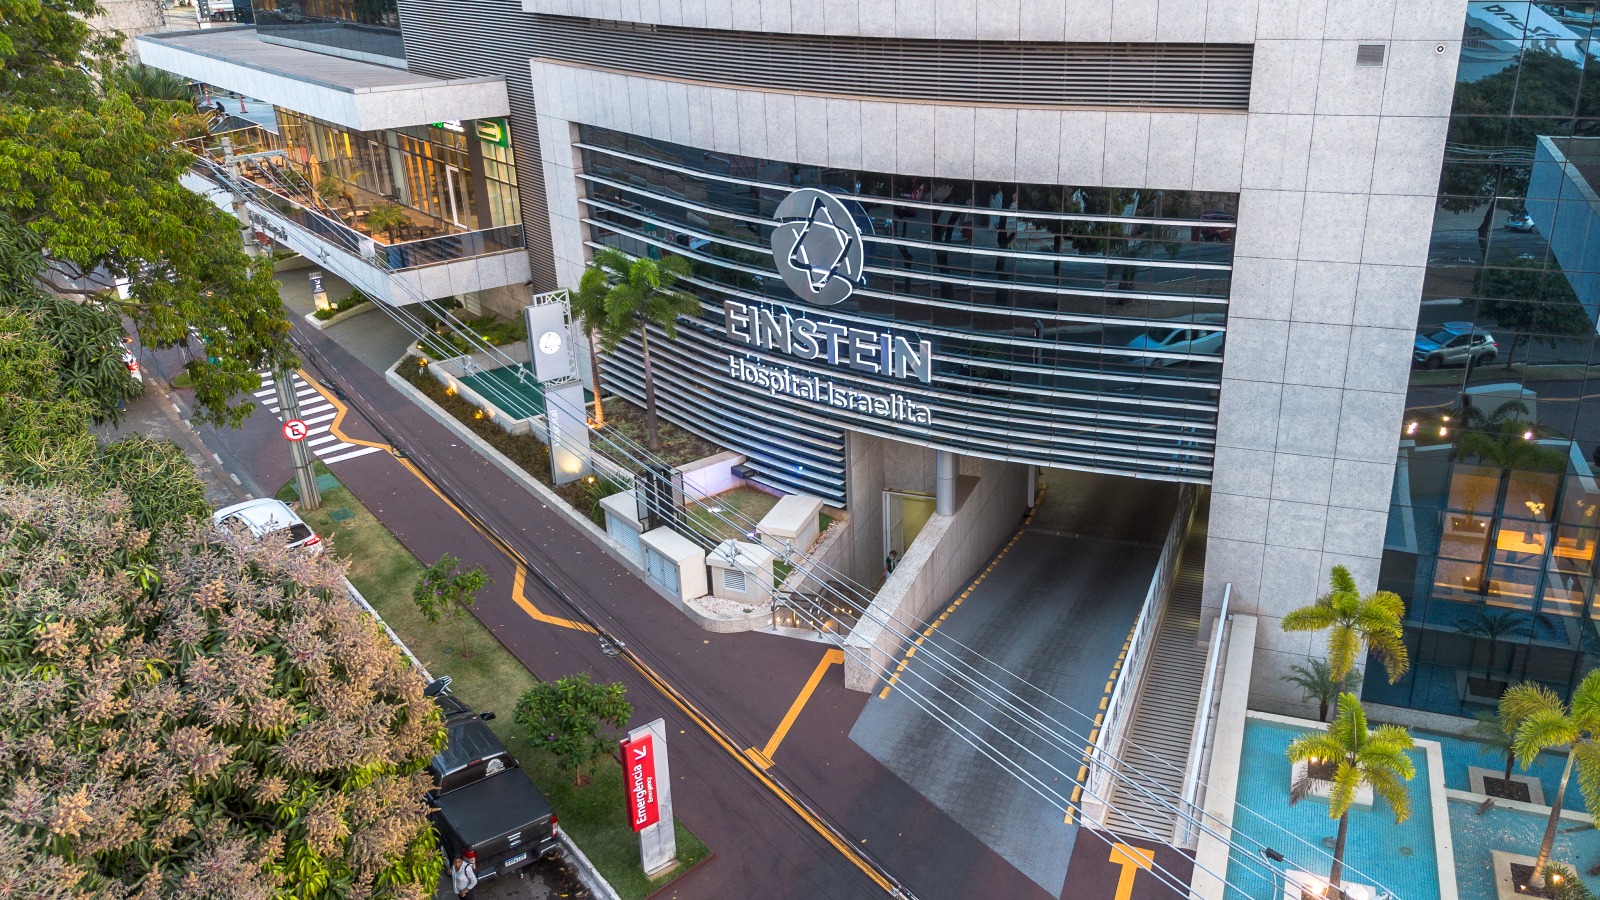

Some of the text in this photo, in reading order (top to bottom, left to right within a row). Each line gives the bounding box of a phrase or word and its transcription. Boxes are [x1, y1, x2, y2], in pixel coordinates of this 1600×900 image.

[724, 300, 931, 383] EINSTEIN
[729, 355, 931, 425] Hospital Israelita
[291, 423, 301, 437] E
[632, 764, 646, 824] Emergência
